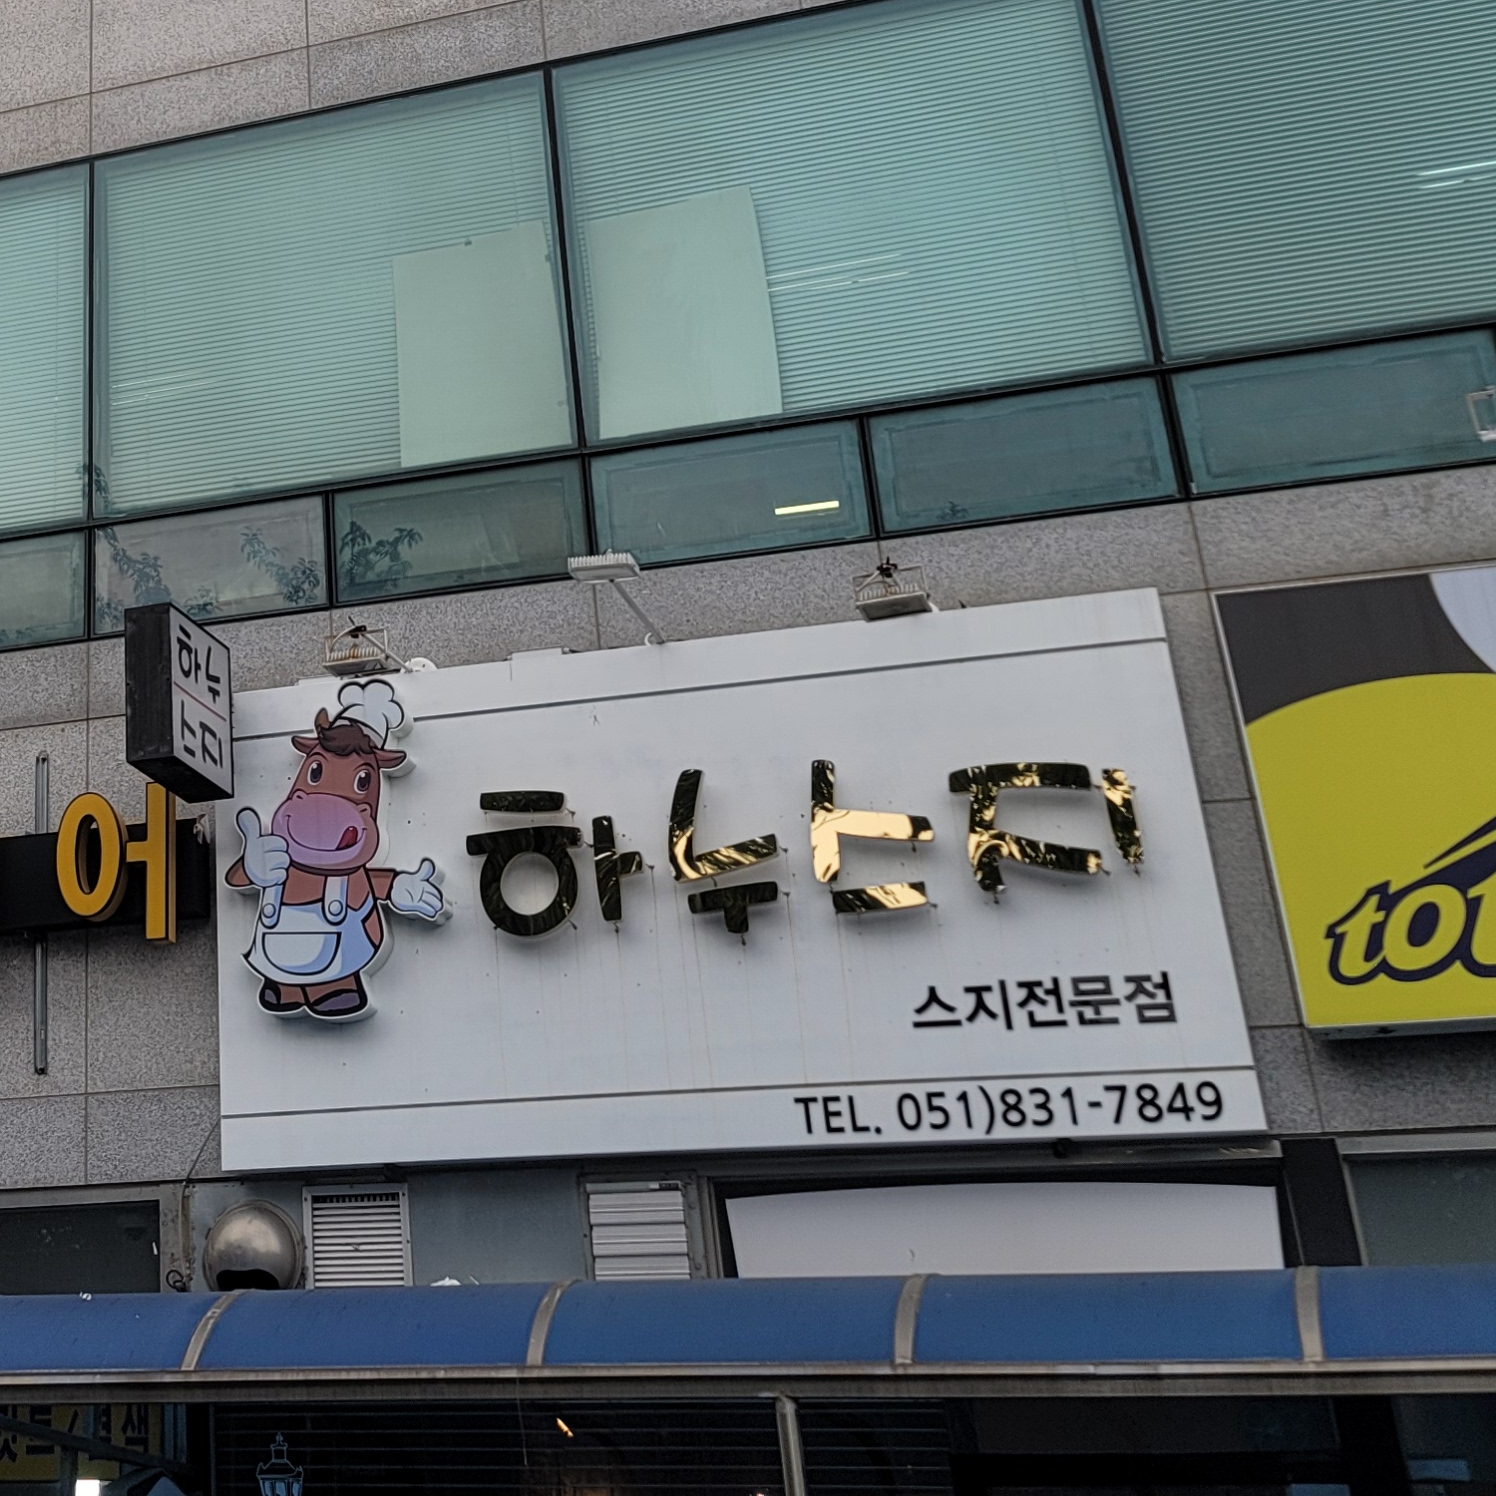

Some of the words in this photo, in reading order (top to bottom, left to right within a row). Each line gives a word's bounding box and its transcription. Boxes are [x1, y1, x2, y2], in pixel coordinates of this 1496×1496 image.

[177, 624, 221, 704] 하누
[912, 971, 1178, 1033] 스지전문점
[794, 1095, 882, 1135] TEL.
[898, 1081, 1223, 1135] 051)831-7849
